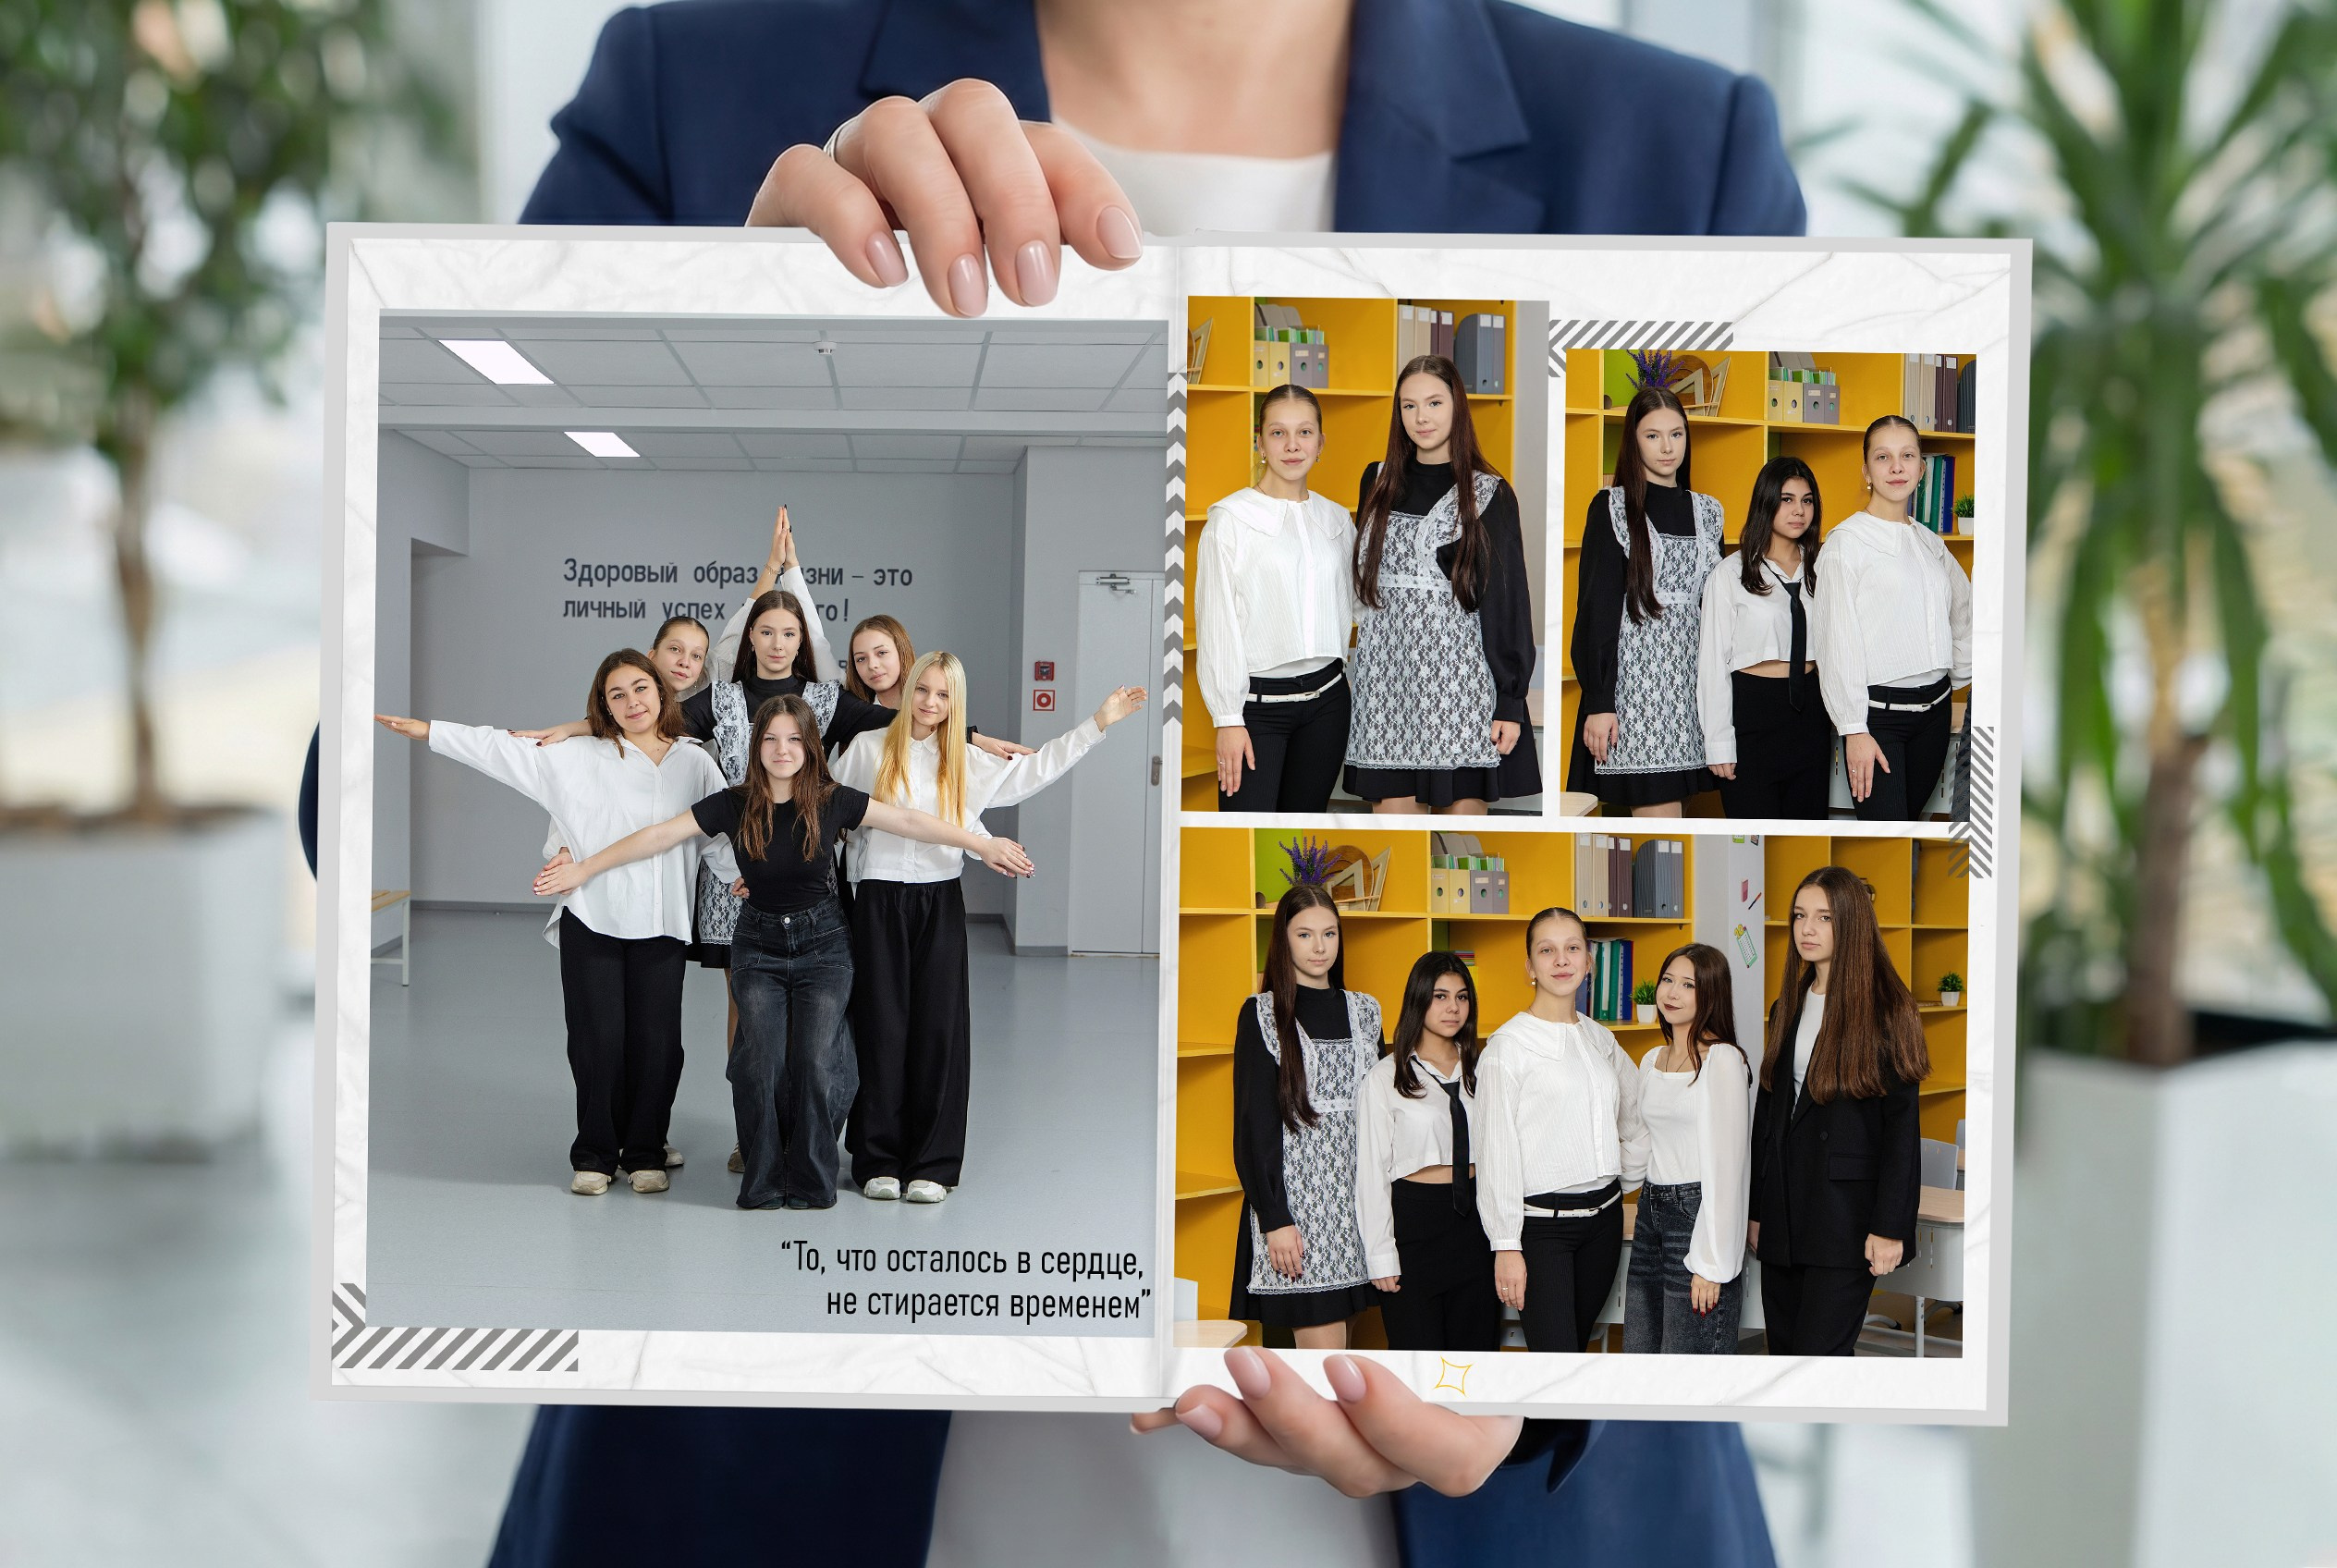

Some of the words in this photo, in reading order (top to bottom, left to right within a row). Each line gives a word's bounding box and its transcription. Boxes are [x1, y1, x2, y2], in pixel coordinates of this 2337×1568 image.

[563, 557, 679, 588] Здоровый
[693, 560, 758, 590] образ
[775, 566, 844, 586] зни
[873, 568, 913, 587] это
[563, 596, 646, 619] личный
[837, 1249, 876, 1272] что
[887, 1249, 1007, 1273] осталось
[1018, 1251, 1031, 1274] в
[1041, 1251, 1144, 1282] сердце,
[827, 1292, 857, 1315] не
[867, 1292, 999, 1324] стирается
